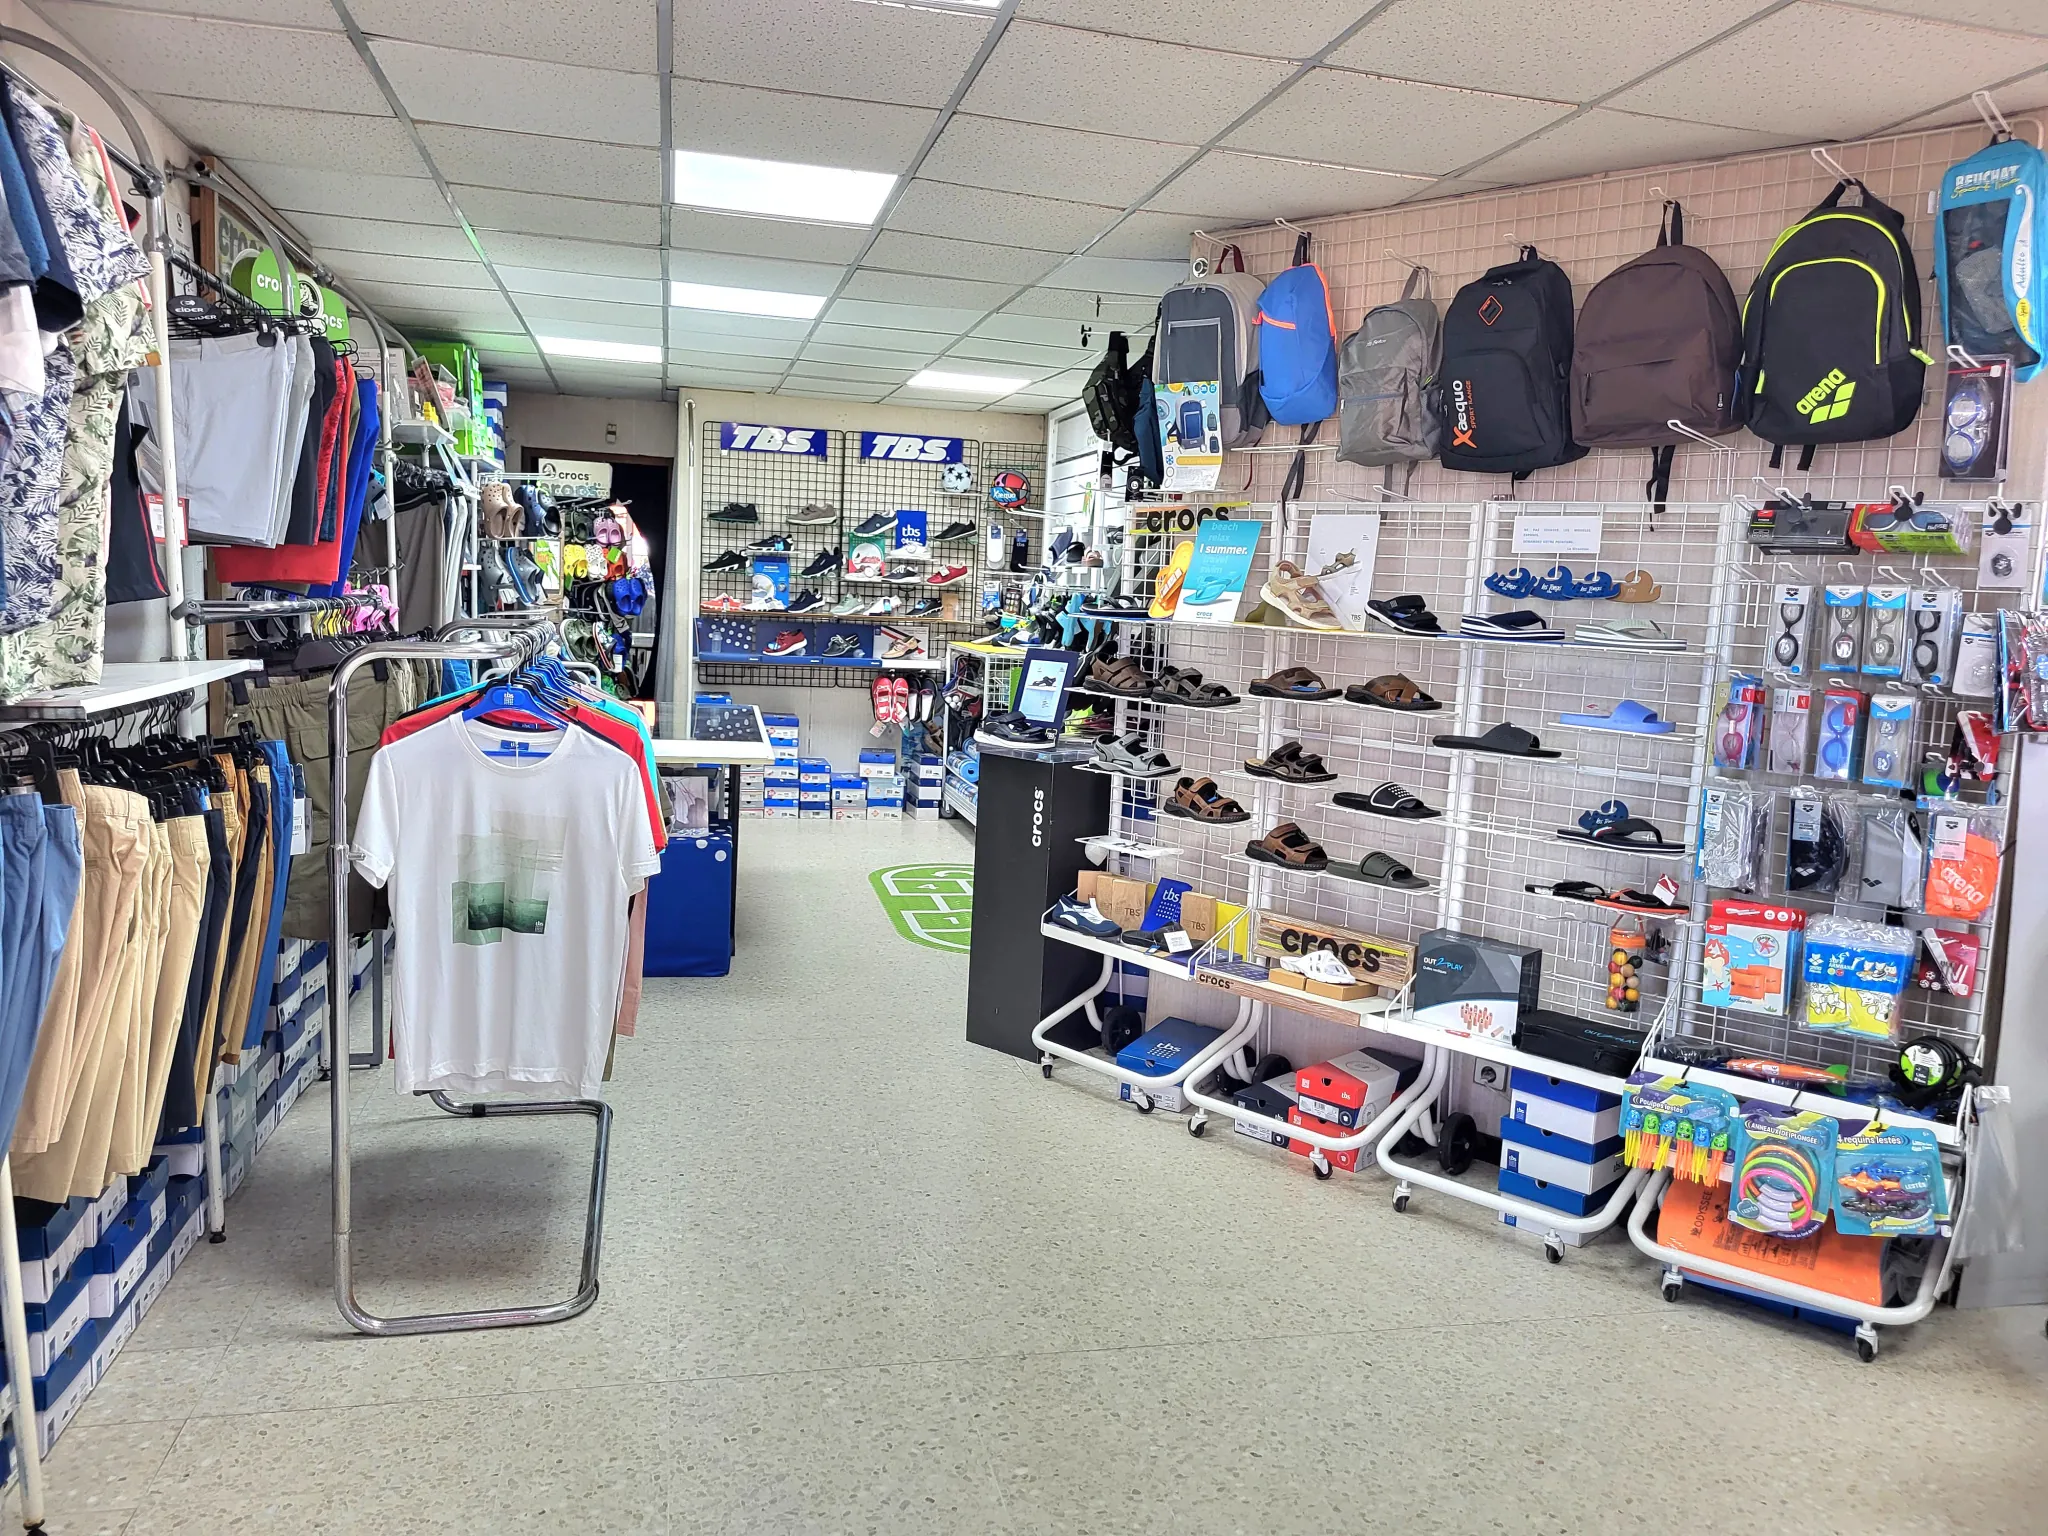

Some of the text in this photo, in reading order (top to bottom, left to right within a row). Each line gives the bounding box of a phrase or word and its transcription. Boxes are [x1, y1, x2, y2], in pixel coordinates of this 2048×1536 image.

[324, 313, 343, 330] ocs
[1796, 368, 1846, 415] arena
[1452, 380, 1477, 448] Xaequo
[1469, 407, 1477, 429] SPORT
[731, 425, 815, 453] TBS
[870, 434, 952, 462] TBS
[558, 470, 590, 481] crocs
[902, 524, 921, 537] tbs
[1205, 545, 1249, 555] summer.
[1032, 789, 1044, 847] crocs
[1163, 887, 1180, 902] tbs
[1941, 867, 1985, 905] arena
[1125, 907, 1141, 917] TBS
[1191, 920, 1206, 931] TBS
[1281, 928, 1380, 973] crocs
[1199, 973, 1231, 990] crocs
[1157, 1042, 1182, 1053] tbs
[1341, 1091, 1350, 1100] tbs
[1640, 1097, 1664, 1109] Poulpes
[1751, 1122, 1779, 1135] ANNEAUX
[1790, 1132, 1818, 1145] PLONGÉE
[1843, 1136, 1875, 1146] requins
[1876, 1136, 1902, 1145] lestés
